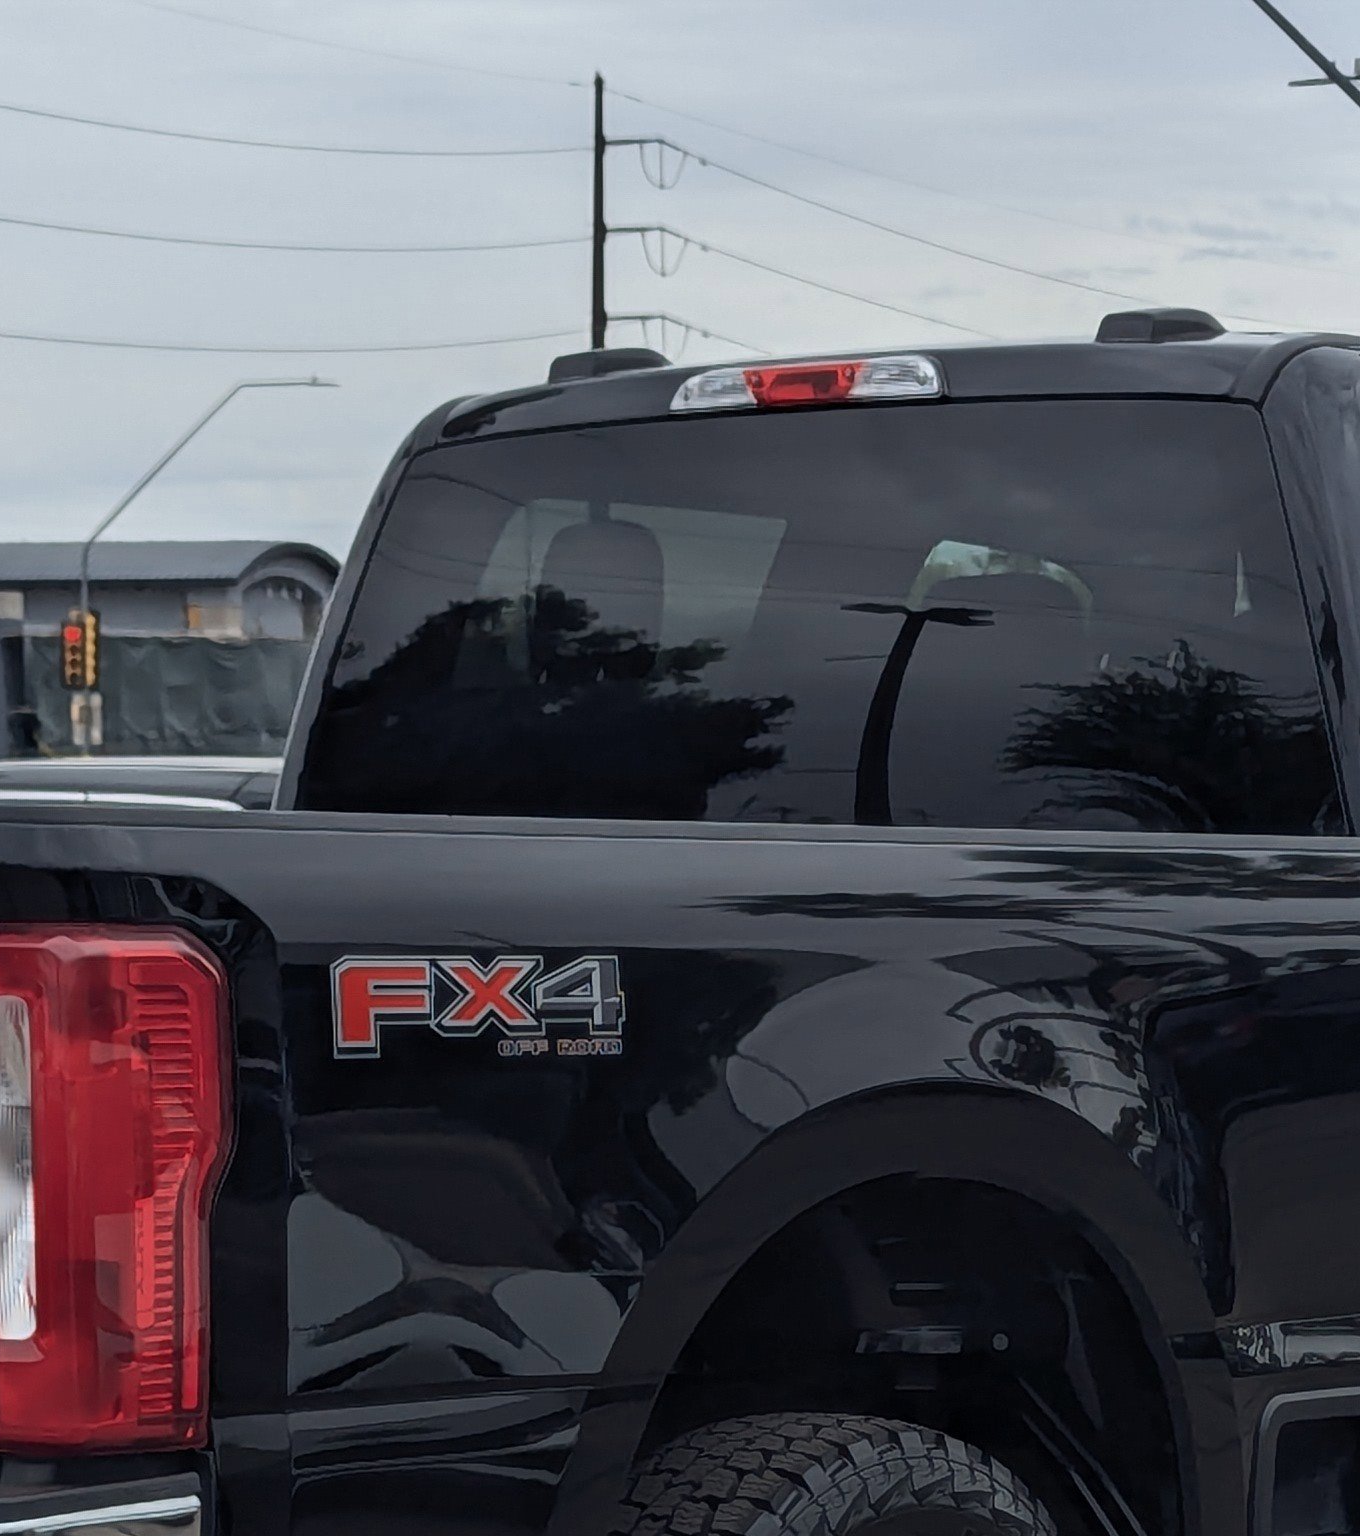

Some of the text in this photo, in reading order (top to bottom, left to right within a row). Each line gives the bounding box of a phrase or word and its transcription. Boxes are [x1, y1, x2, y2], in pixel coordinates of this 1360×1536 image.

[329, 955, 627, 1059] FX4
[497, 1039, 623, 1056] OFF ROAD
